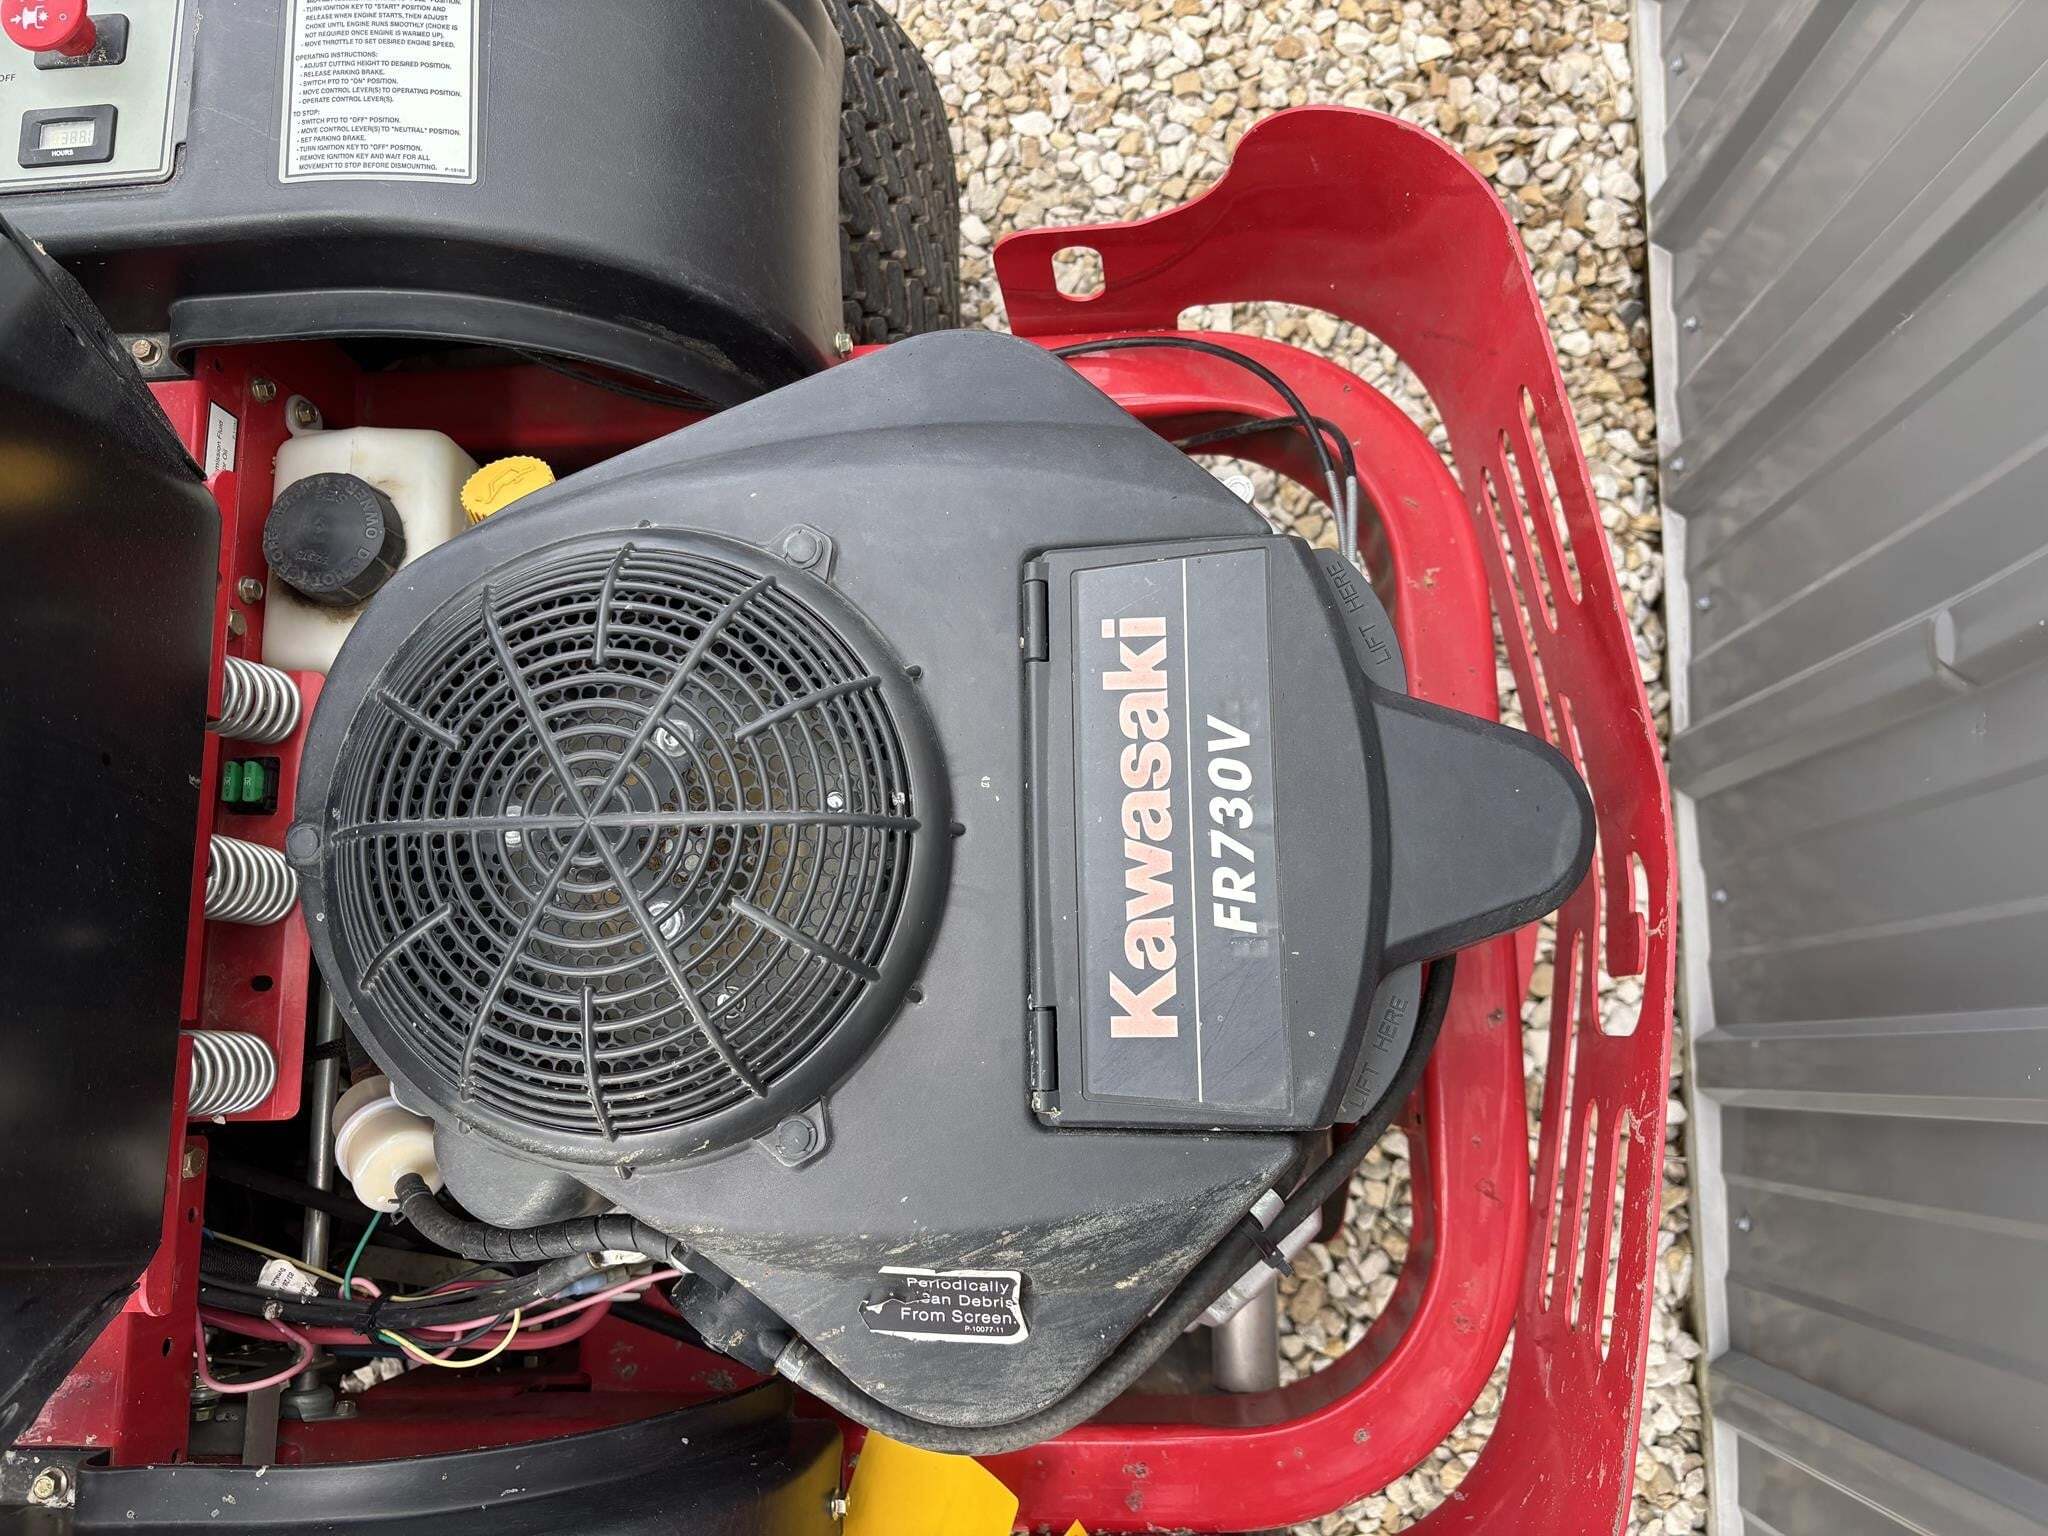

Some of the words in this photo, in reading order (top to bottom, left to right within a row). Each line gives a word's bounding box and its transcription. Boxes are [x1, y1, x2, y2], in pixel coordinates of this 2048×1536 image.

[51, 149, 74, 157] HOURS
[216, 420, 224, 439] Fluid
[1326, 560, 1365, 613] HERE
[1358, 624, 1392, 665] LIFT
[1101, 616, 1179, 1039] Kawasaki
[1206, 714, 1258, 935] FR730V
[1345, 1061, 1379, 1108] LIFT
[1372, 996, 1408, 1053] HERE
[906, 1277, 1009, 1295] Periodically
[900, 1307, 946, 1322] From
[951, 1309, 1017, 1325] Screen.
[958, 1294, 1014, 1309] Debris
